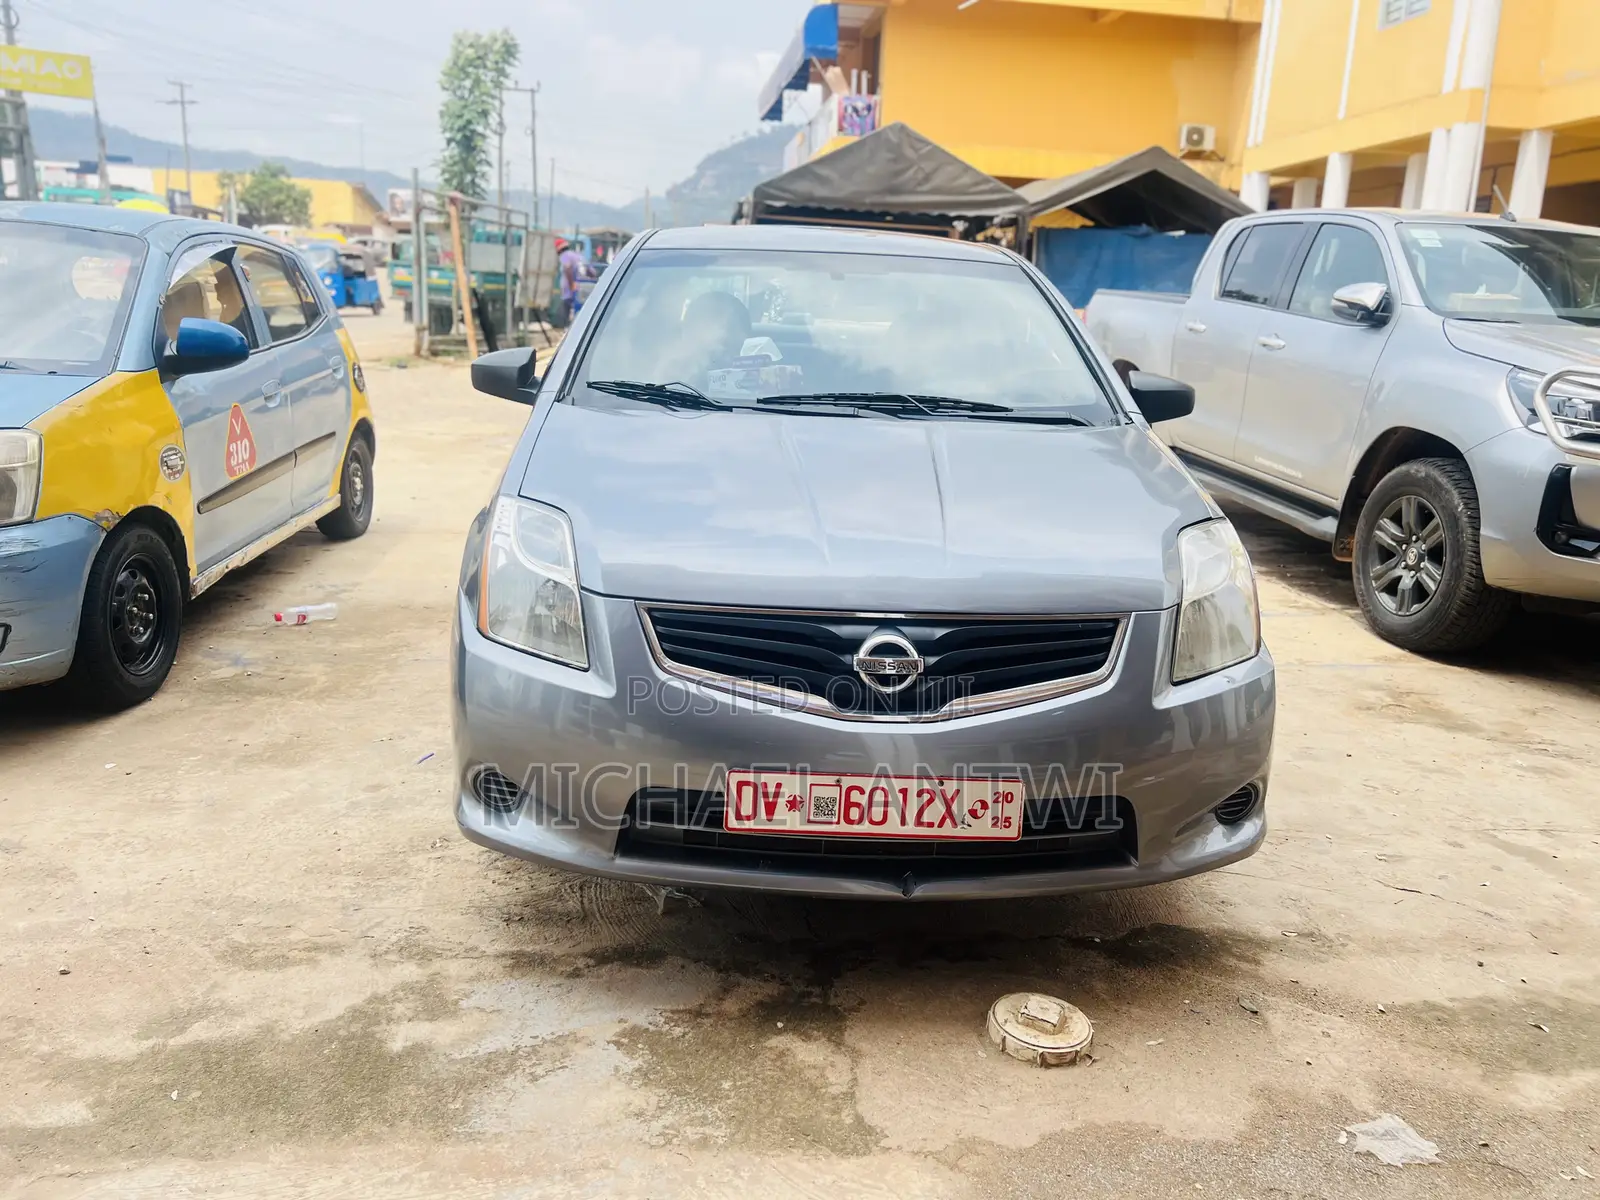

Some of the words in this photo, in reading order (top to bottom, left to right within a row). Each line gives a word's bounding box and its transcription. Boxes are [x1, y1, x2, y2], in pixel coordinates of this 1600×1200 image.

[232, 416, 242, 436] V
[229, 438, 250, 468] 310
[861, 660, 919, 673] NISSAN
[734, 779, 783, 823] DV
[842, 784, 961, 829] 6012X
[992, 791, 1014, 804] 20
[990, 815, 1012, 829] 25
